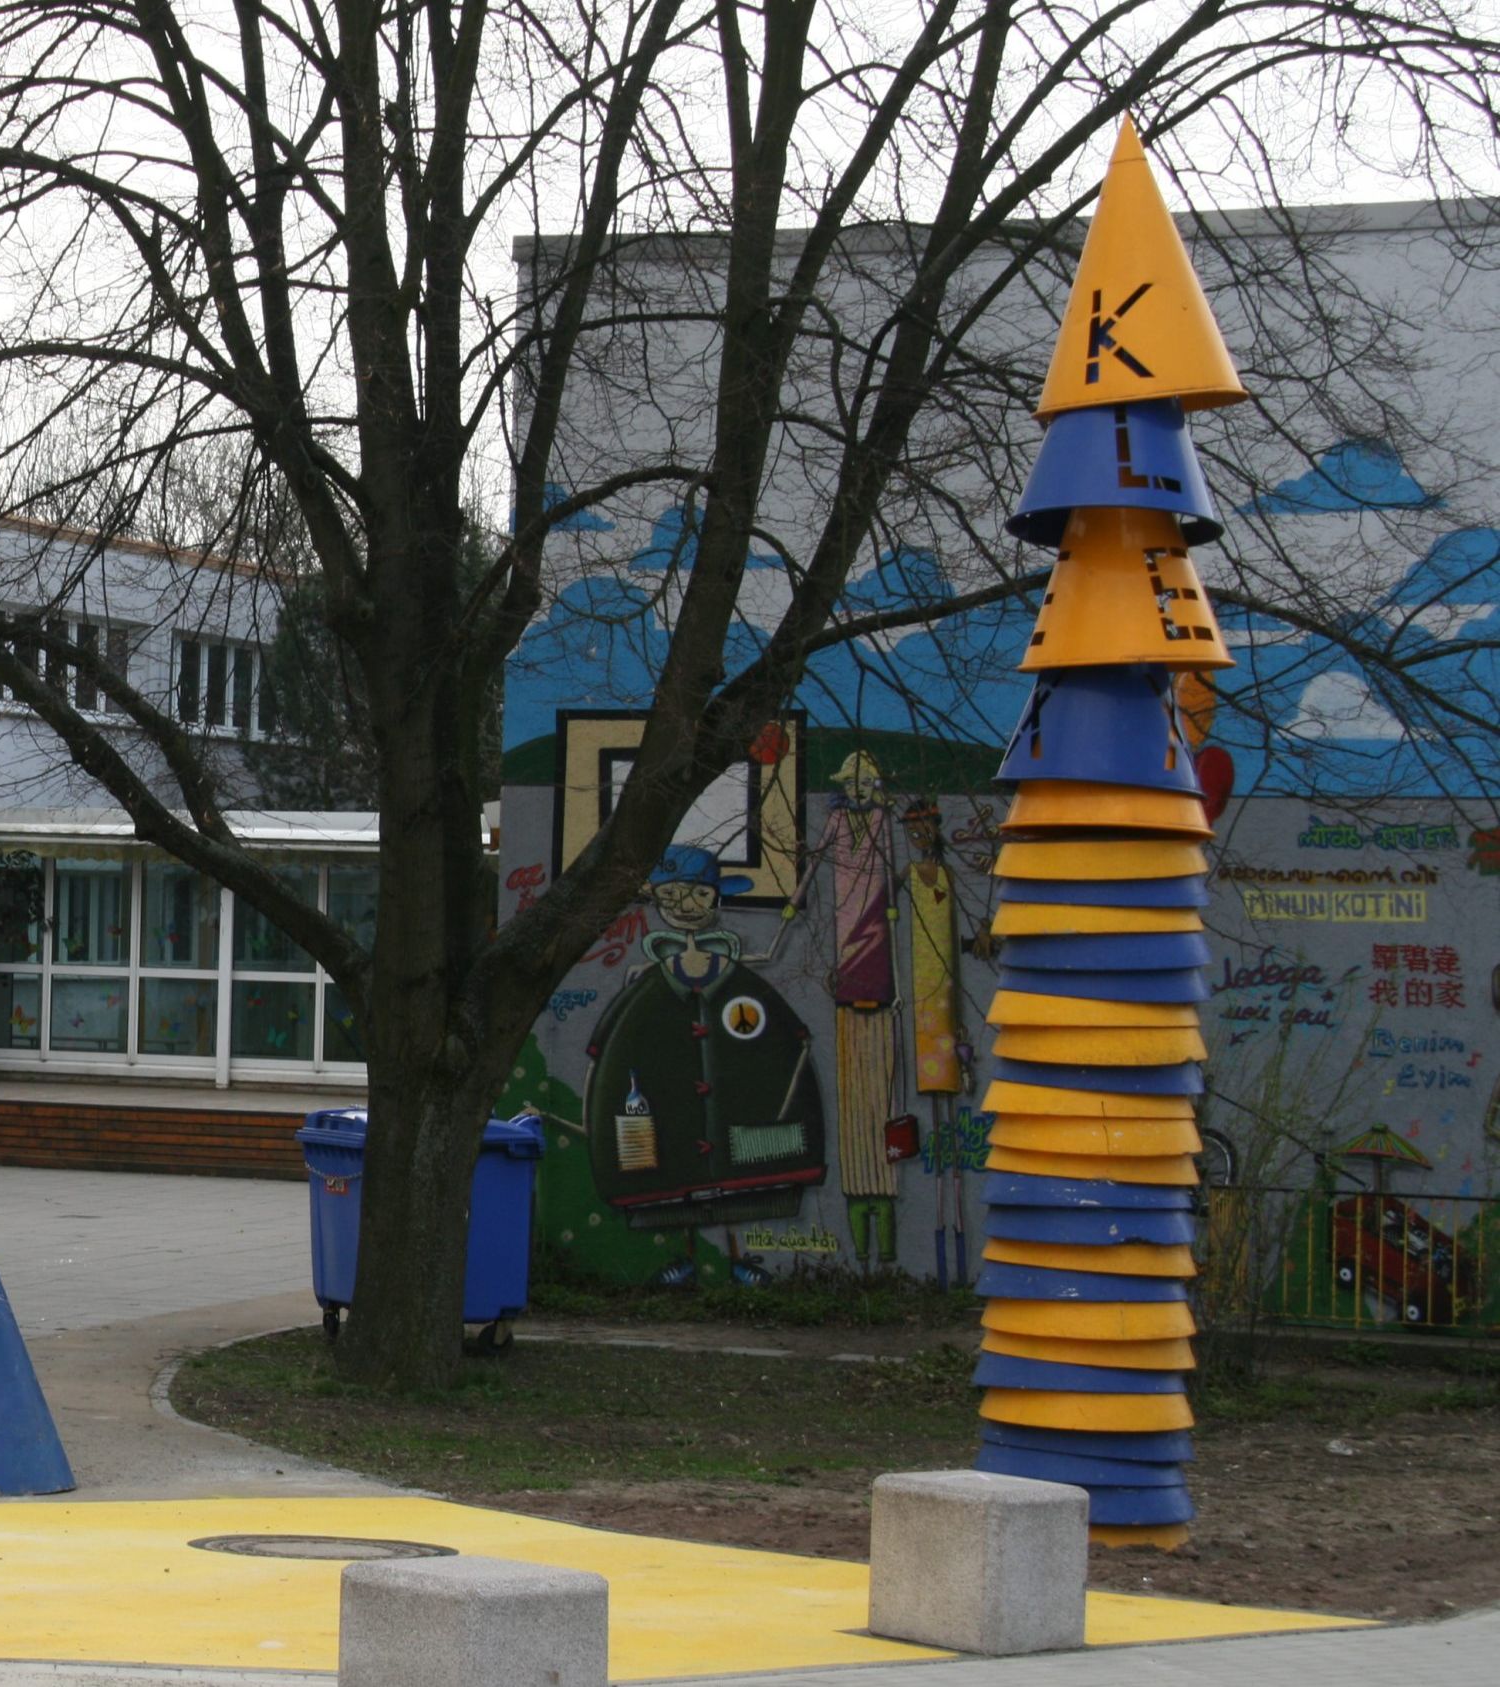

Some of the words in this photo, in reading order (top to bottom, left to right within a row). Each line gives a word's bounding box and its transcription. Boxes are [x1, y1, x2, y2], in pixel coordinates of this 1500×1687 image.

[1368, 978, 1467, 1009] 我的家
[1397, 1063, 1471, 1089] Evim
